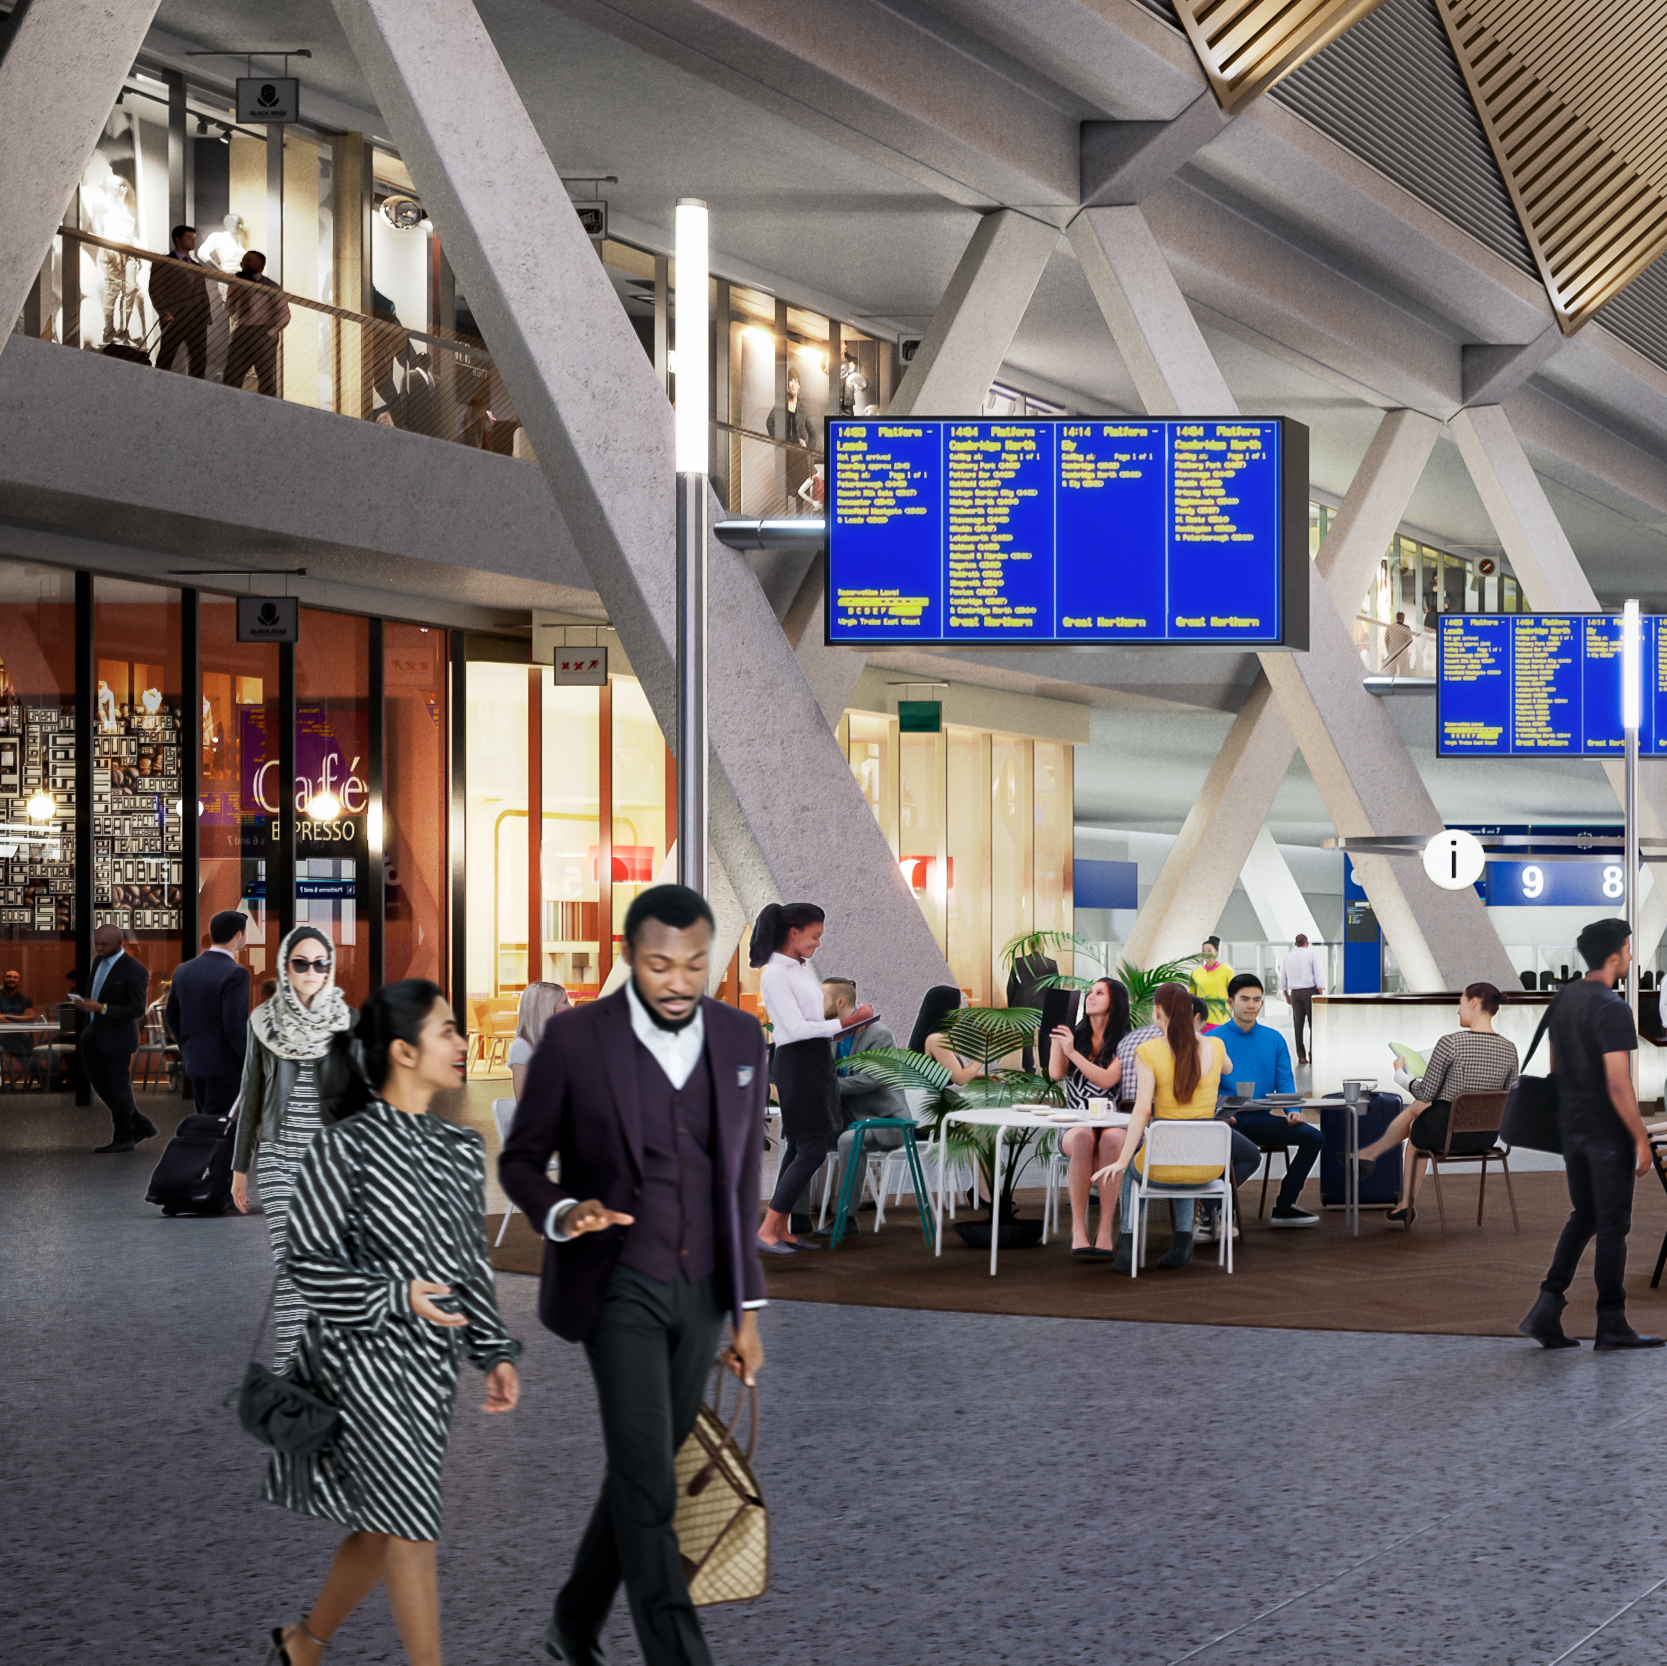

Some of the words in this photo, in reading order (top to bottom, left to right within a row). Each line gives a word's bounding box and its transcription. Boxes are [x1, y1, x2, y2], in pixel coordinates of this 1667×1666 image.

[1063, 426, 1092, 438] 14:14
[253, 753, 369, 814] Café
[112, 859, 182, 884] ROBUST
[1522, 866, 1544, 898] 9
[1602, 866, 1624, 899] 8
[134, 910, 178, 929] BLACK
